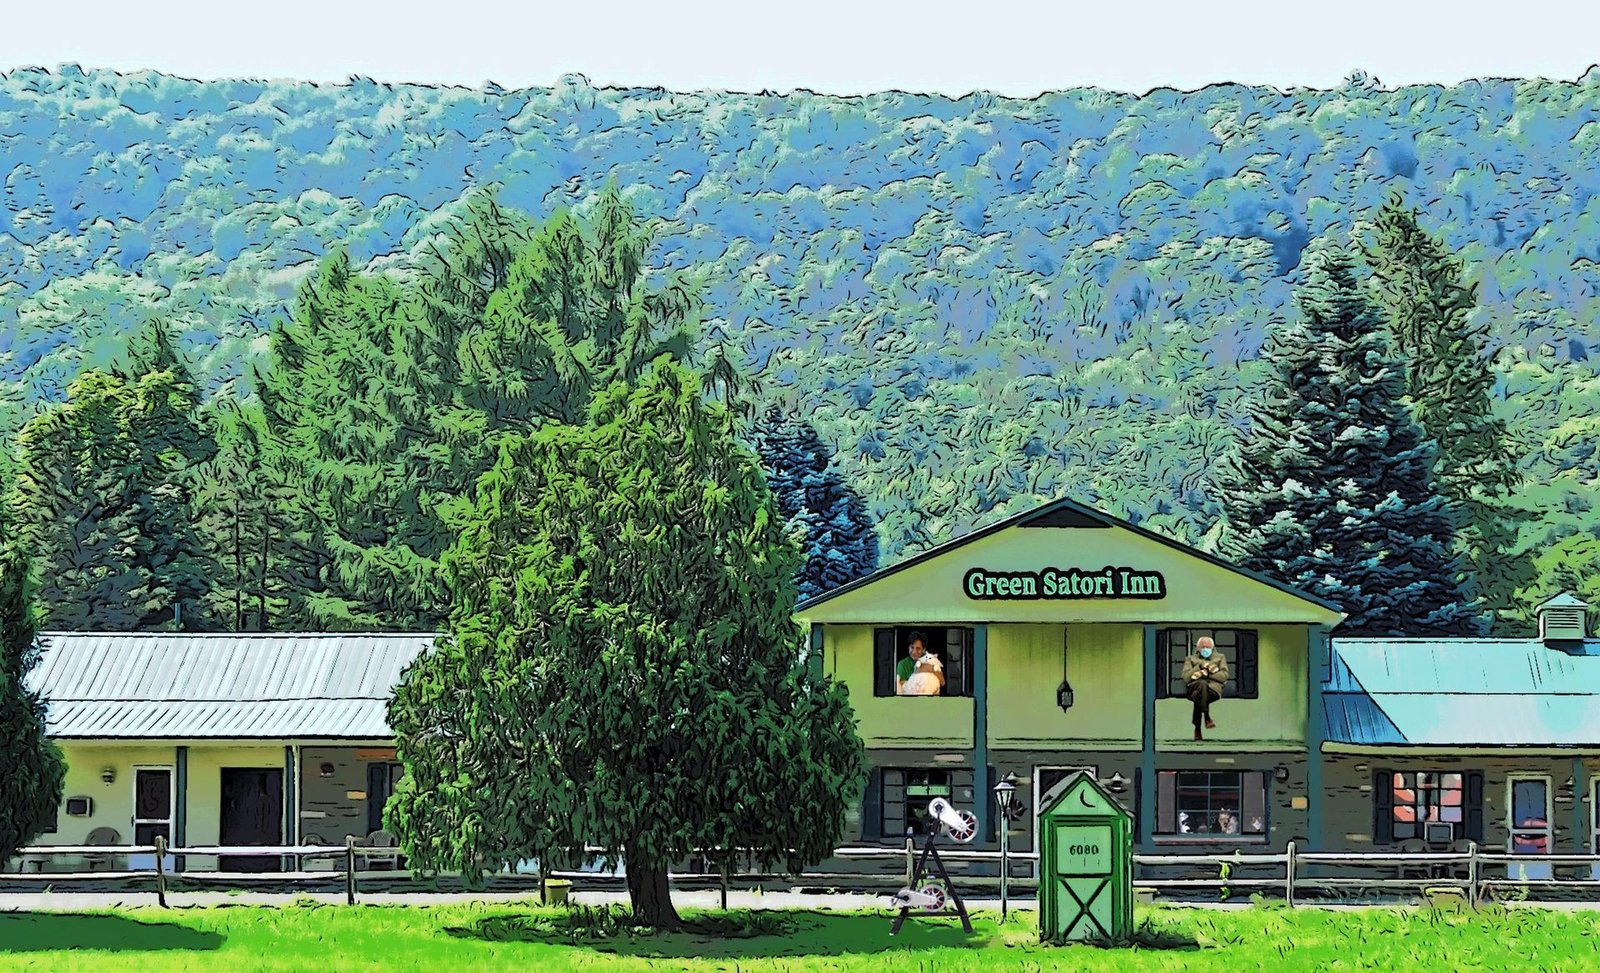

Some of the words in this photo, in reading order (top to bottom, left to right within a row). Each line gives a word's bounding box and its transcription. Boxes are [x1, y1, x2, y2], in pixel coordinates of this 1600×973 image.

[968, 572, 1037, 596] Green
[1043, 571, 1114, 596] Satori
[1119, 571, 1161, 595] Inn
[1069, 844, 1099, 856] 6080
